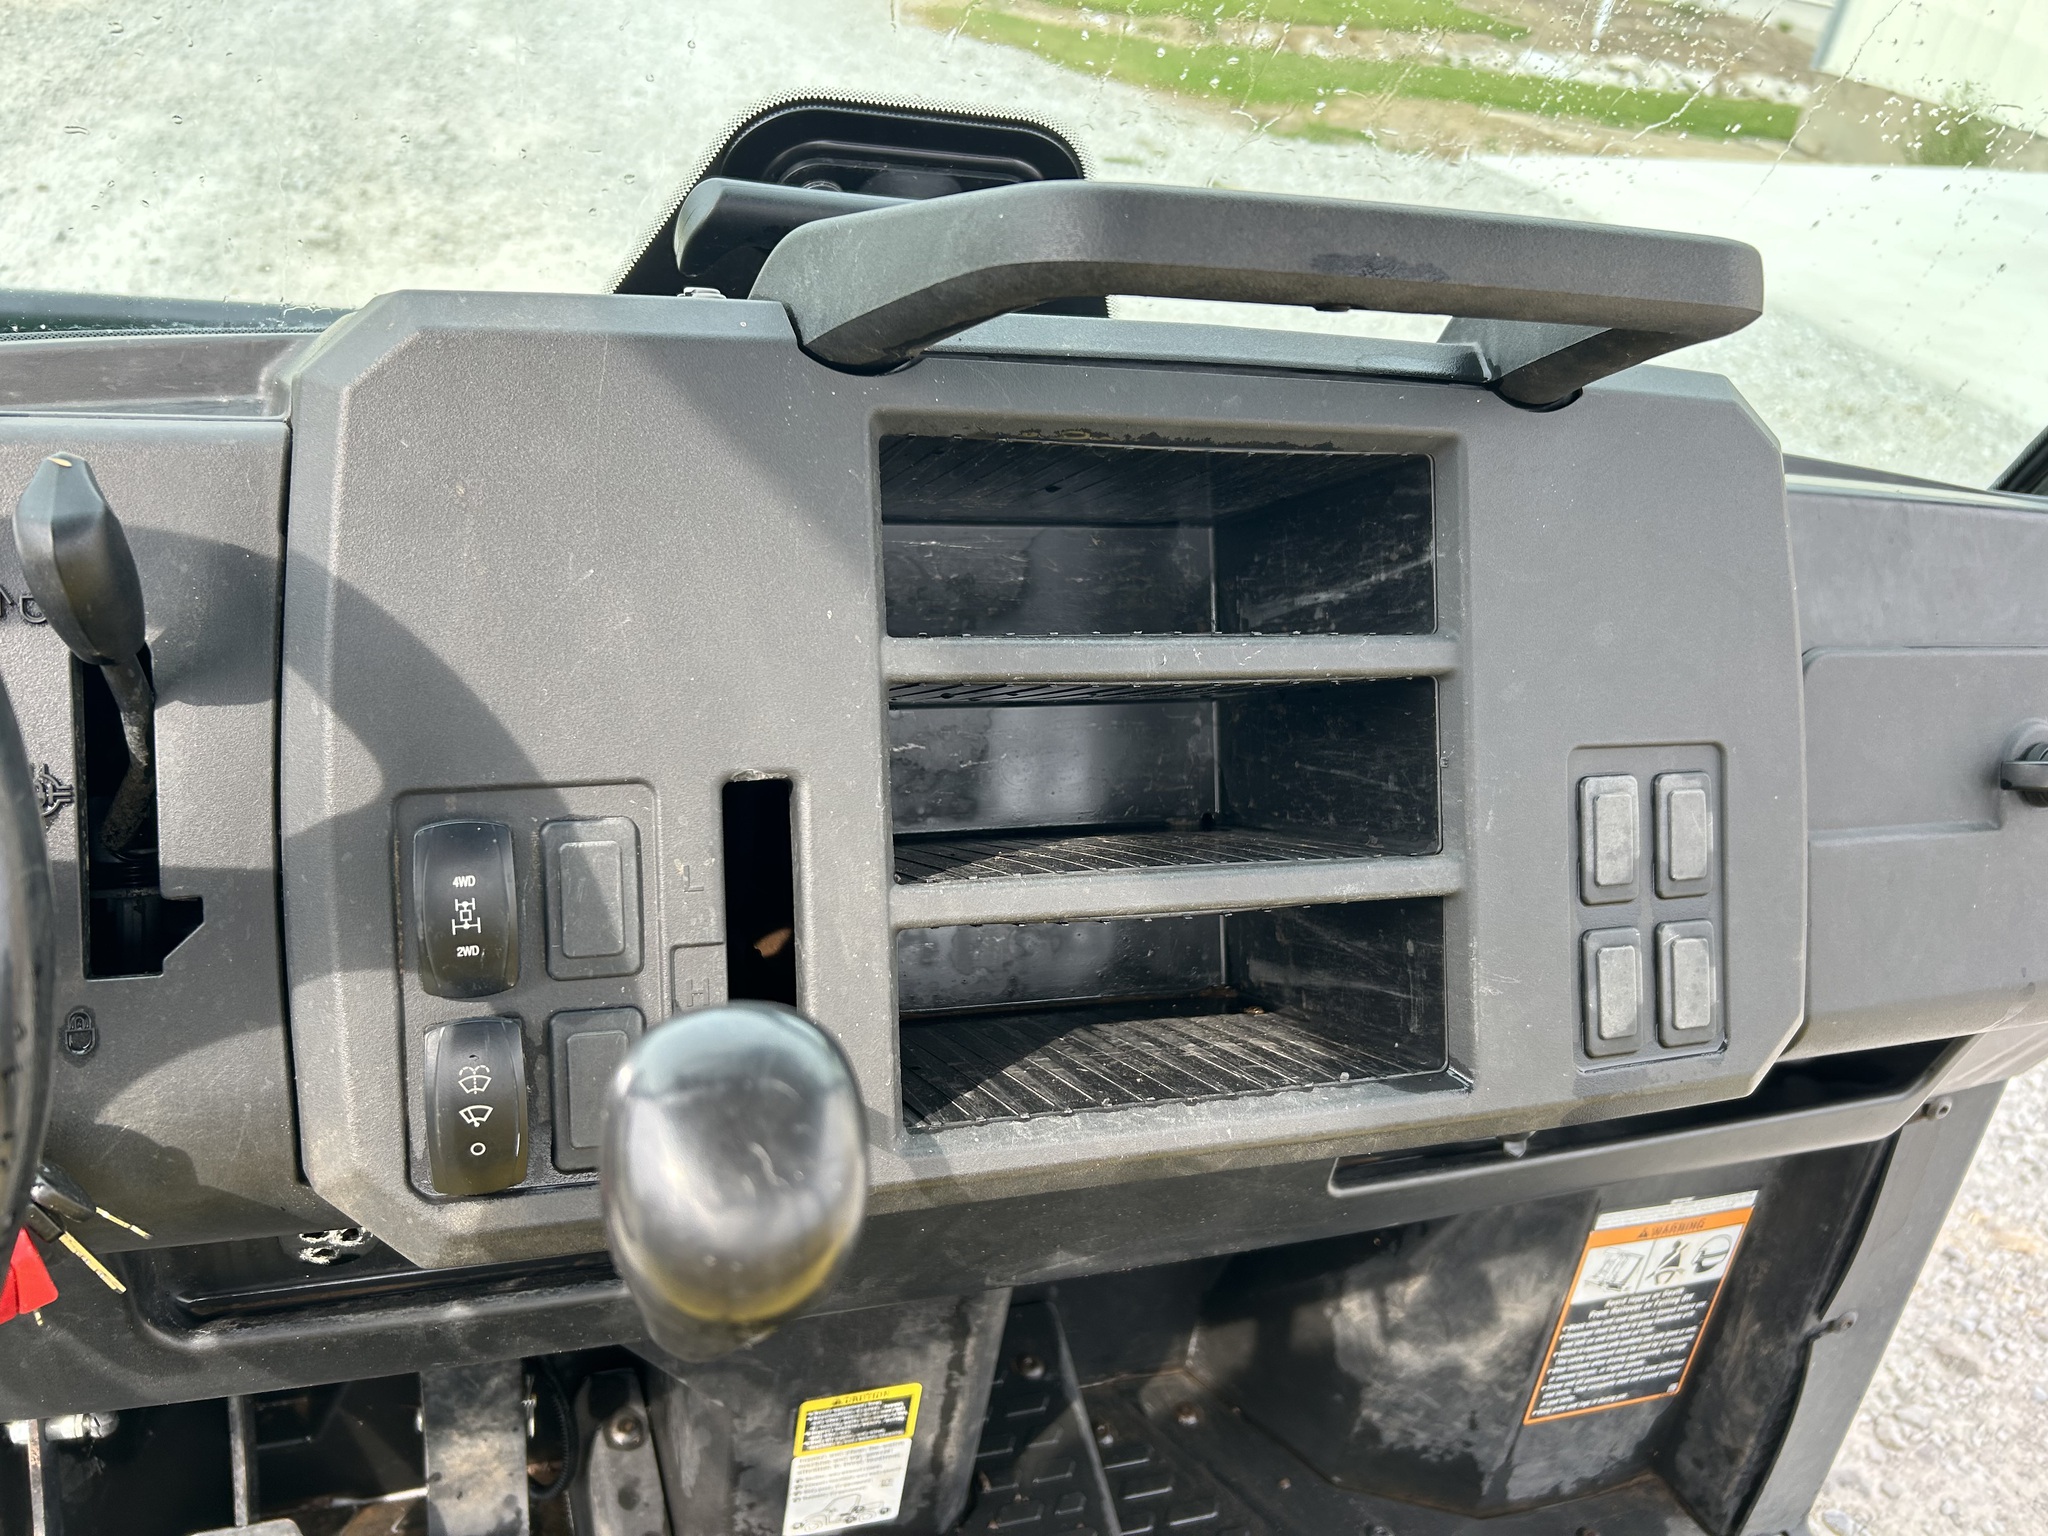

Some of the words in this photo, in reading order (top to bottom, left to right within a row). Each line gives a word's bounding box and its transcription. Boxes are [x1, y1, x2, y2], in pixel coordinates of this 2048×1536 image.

[452, 875, 476, 888] 4WD
[683, 865, 704, 892] L
[456, 945, 480, 957] 2WD
[685, 978, 710, 1007] H
[1652, 1217, 1706, 1235] WARNING
